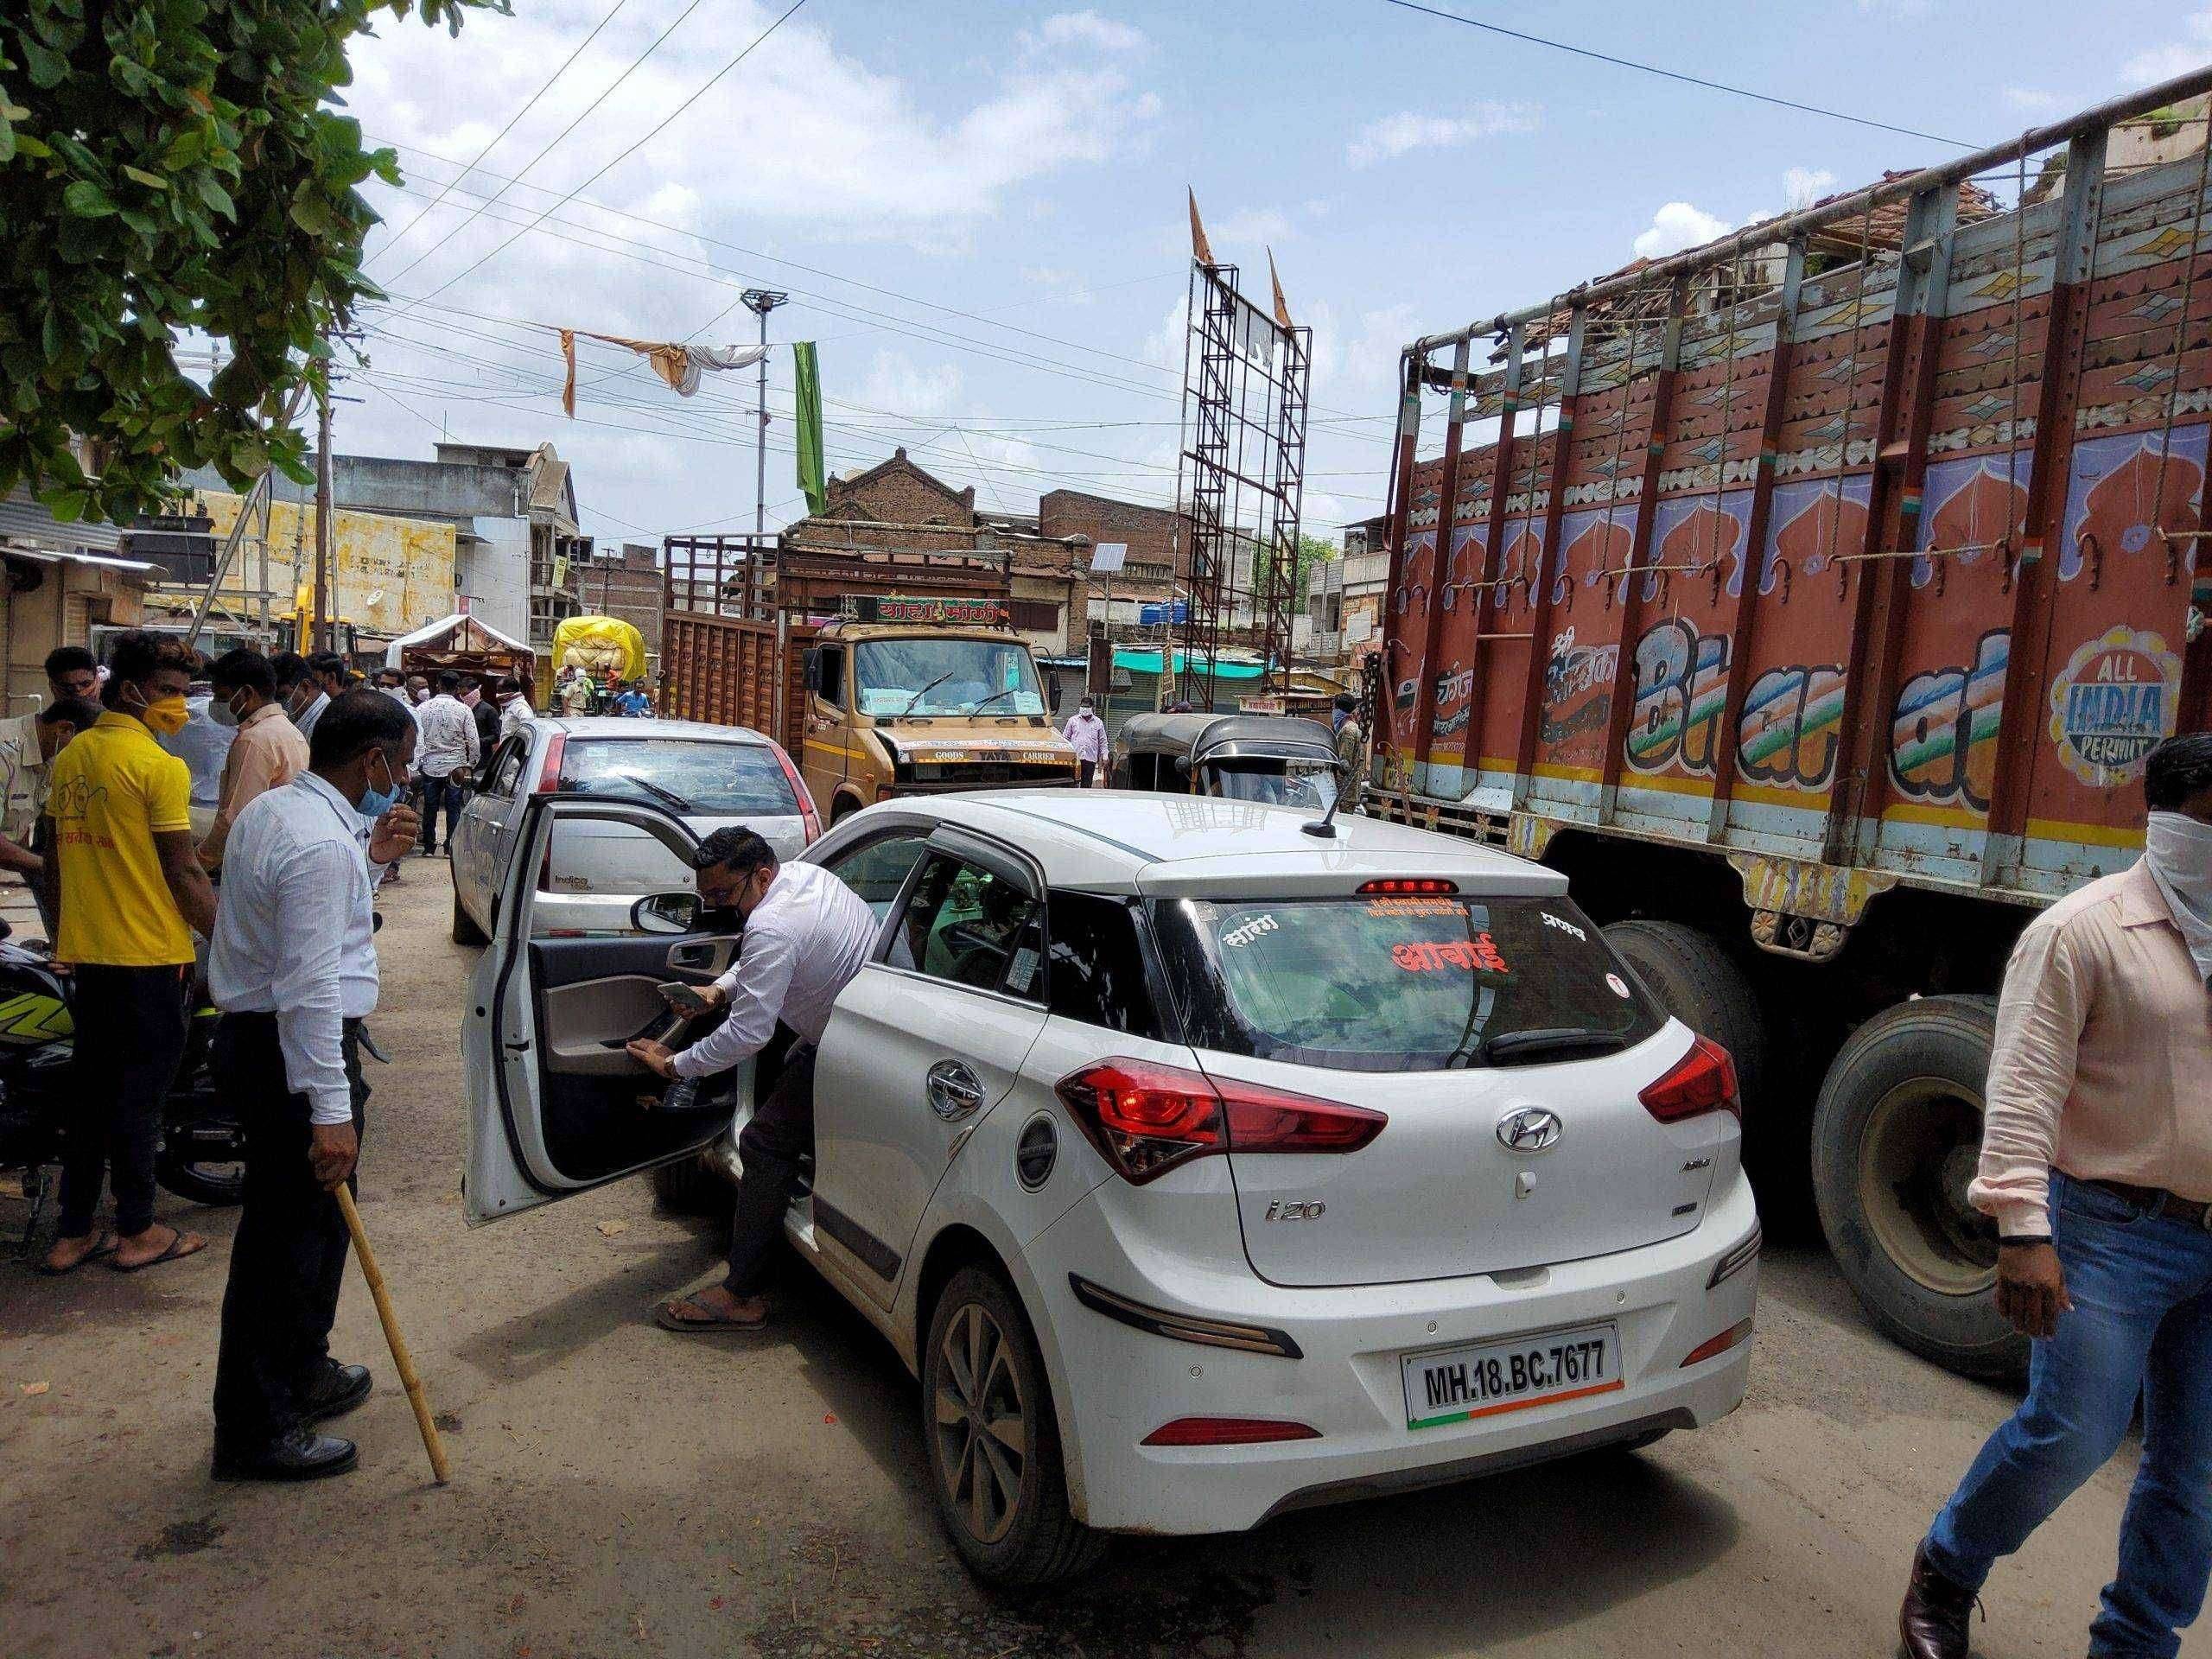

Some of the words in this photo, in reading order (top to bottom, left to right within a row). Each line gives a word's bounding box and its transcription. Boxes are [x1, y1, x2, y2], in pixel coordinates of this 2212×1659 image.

[2097, 654, 2138, 682] ALL
[2066, 684, 2162, 733] INDIA
[935, 751, 964, 760] GOODS
[1022, 751, 1056, 760] CARRIER
[2080, 734, 2150, 763] PERMIT
[1222, 914, 1280, 948] सारंग
[1265, 1198, 1326, 1222] i20
